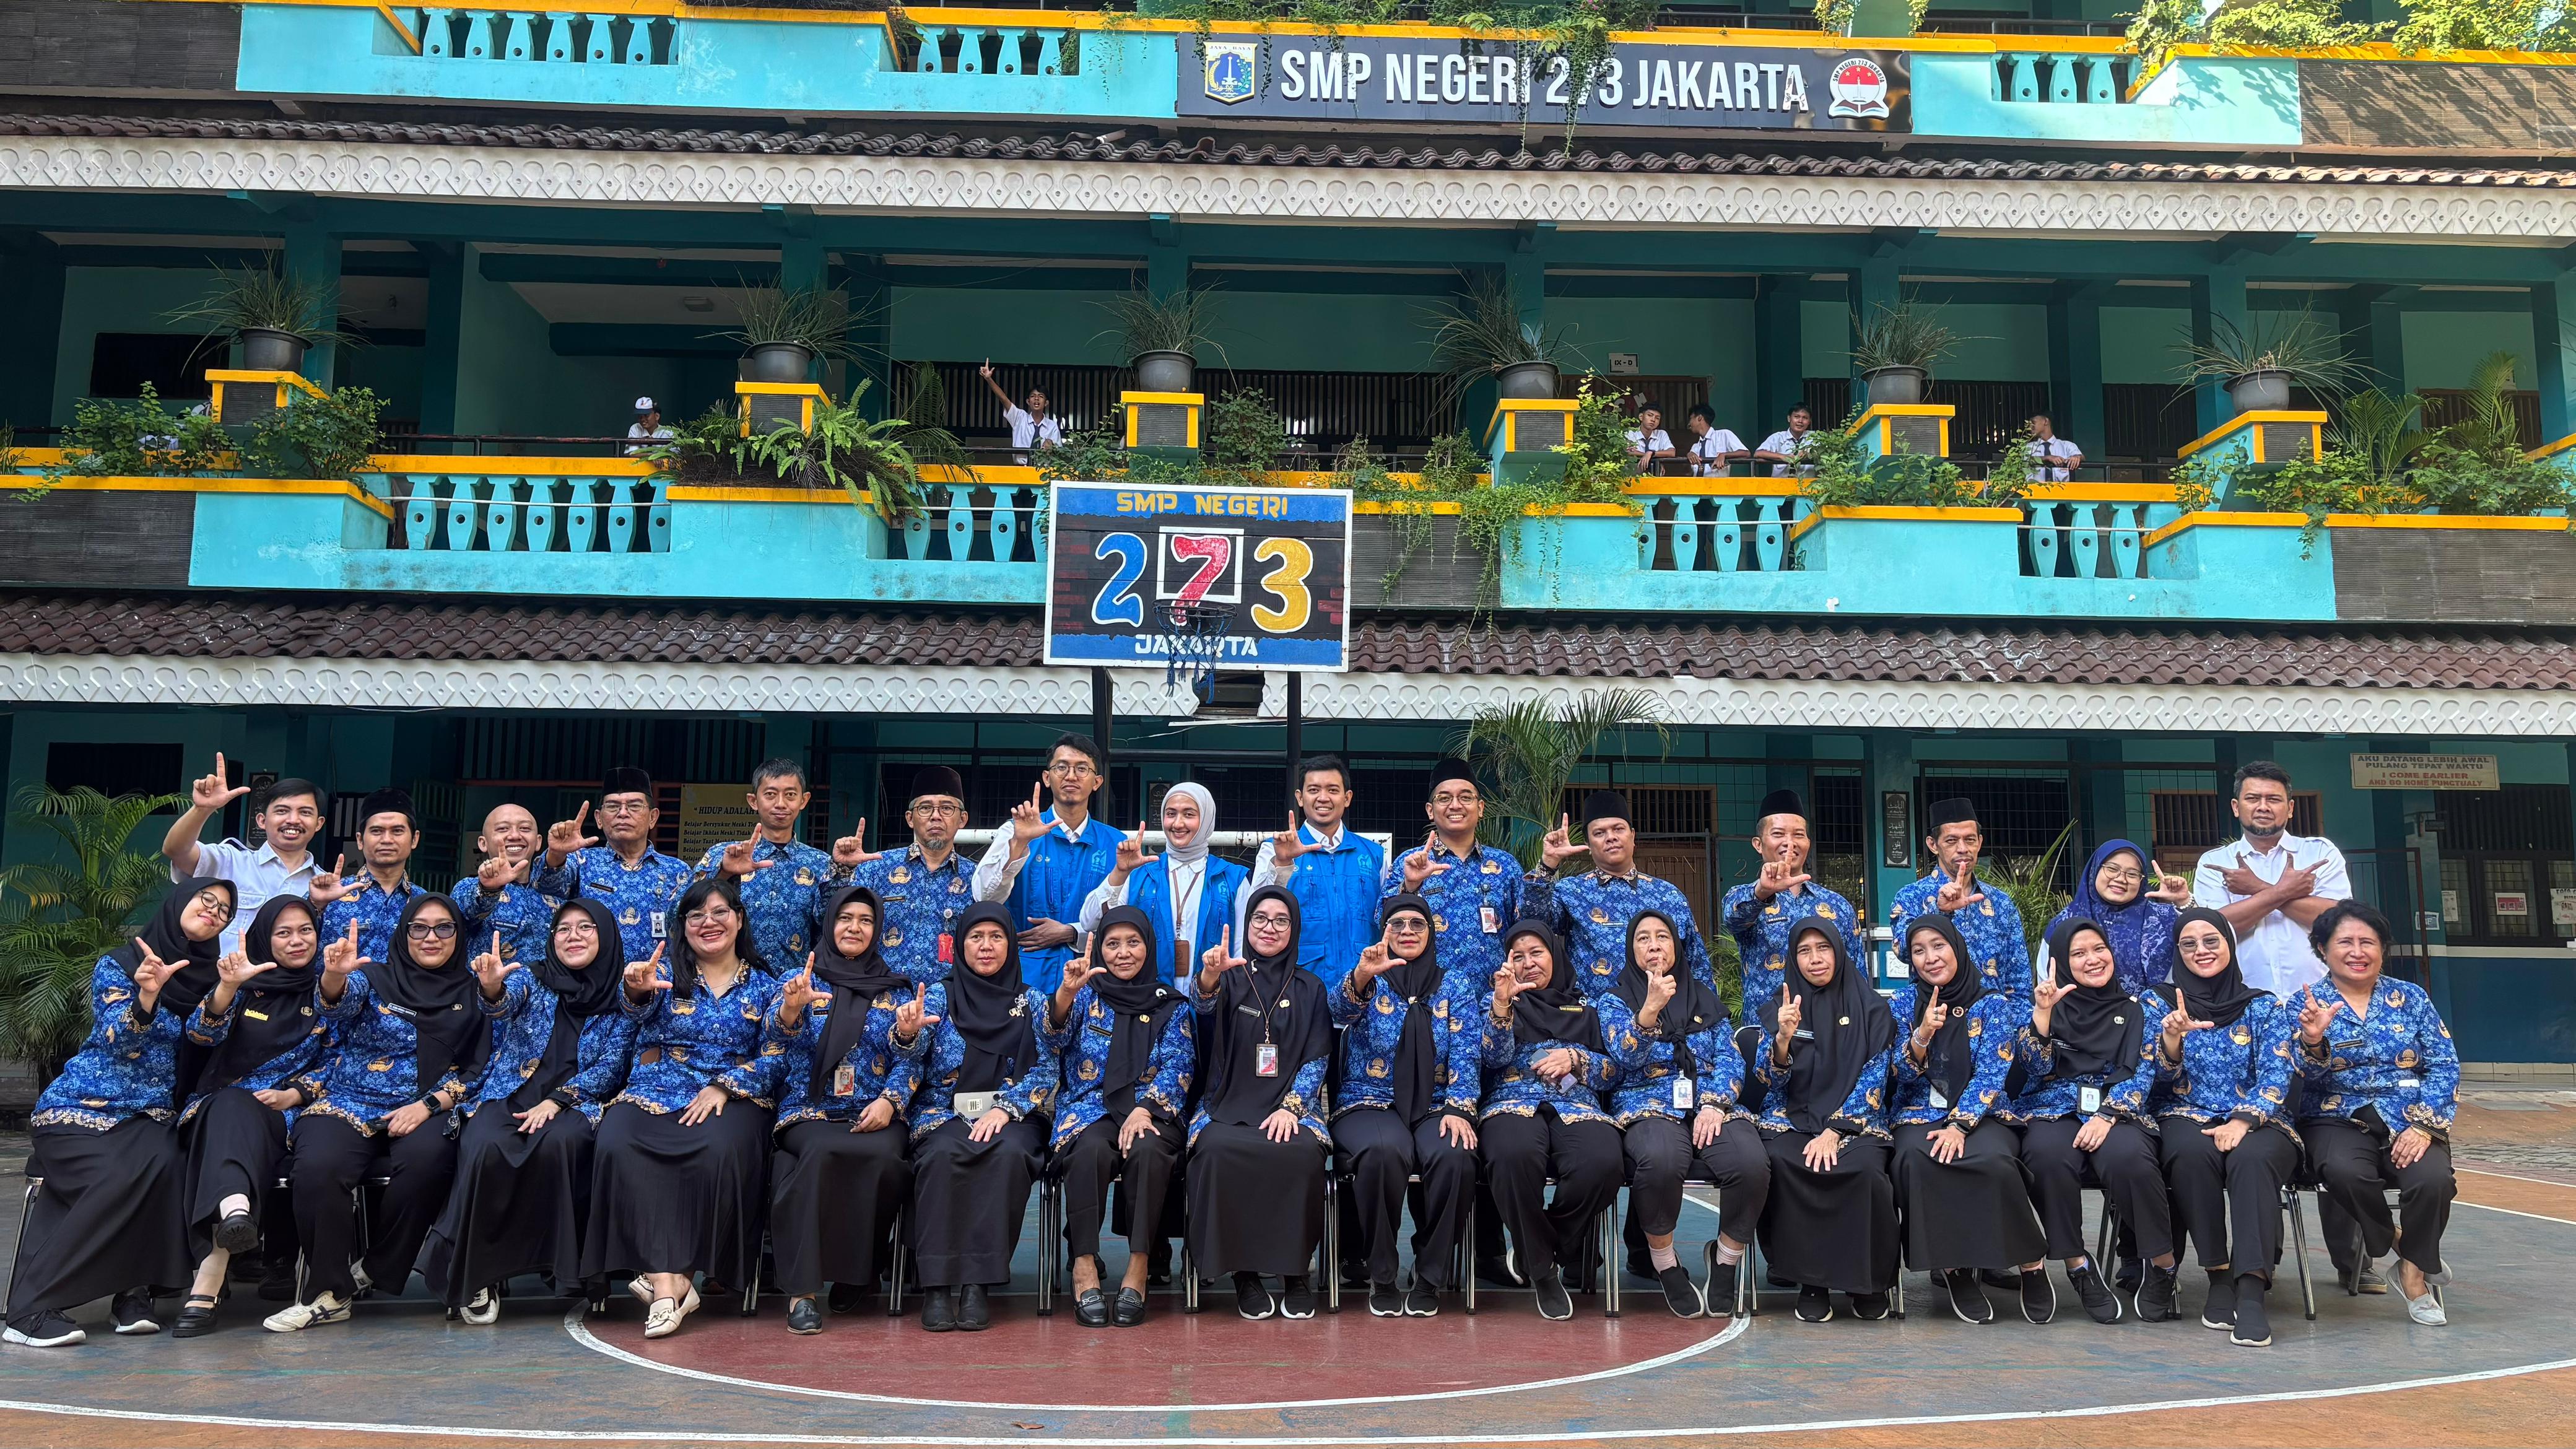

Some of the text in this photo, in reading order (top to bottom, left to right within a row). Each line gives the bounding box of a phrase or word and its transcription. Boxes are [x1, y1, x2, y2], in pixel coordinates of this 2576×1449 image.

[1281, 49, 1372, 101] SMP
[1386, 53, 1531, 103] NEGERI
[1632, 59, 1809, 111] JAKARTA
[1116, 492, 1287, 518] SMP NEGERI
[1135, 633, 1258, 658] JAKARTA
[698, 806, 722, 814] HIDUP
[723, 807, 754, 815] ADALAH
